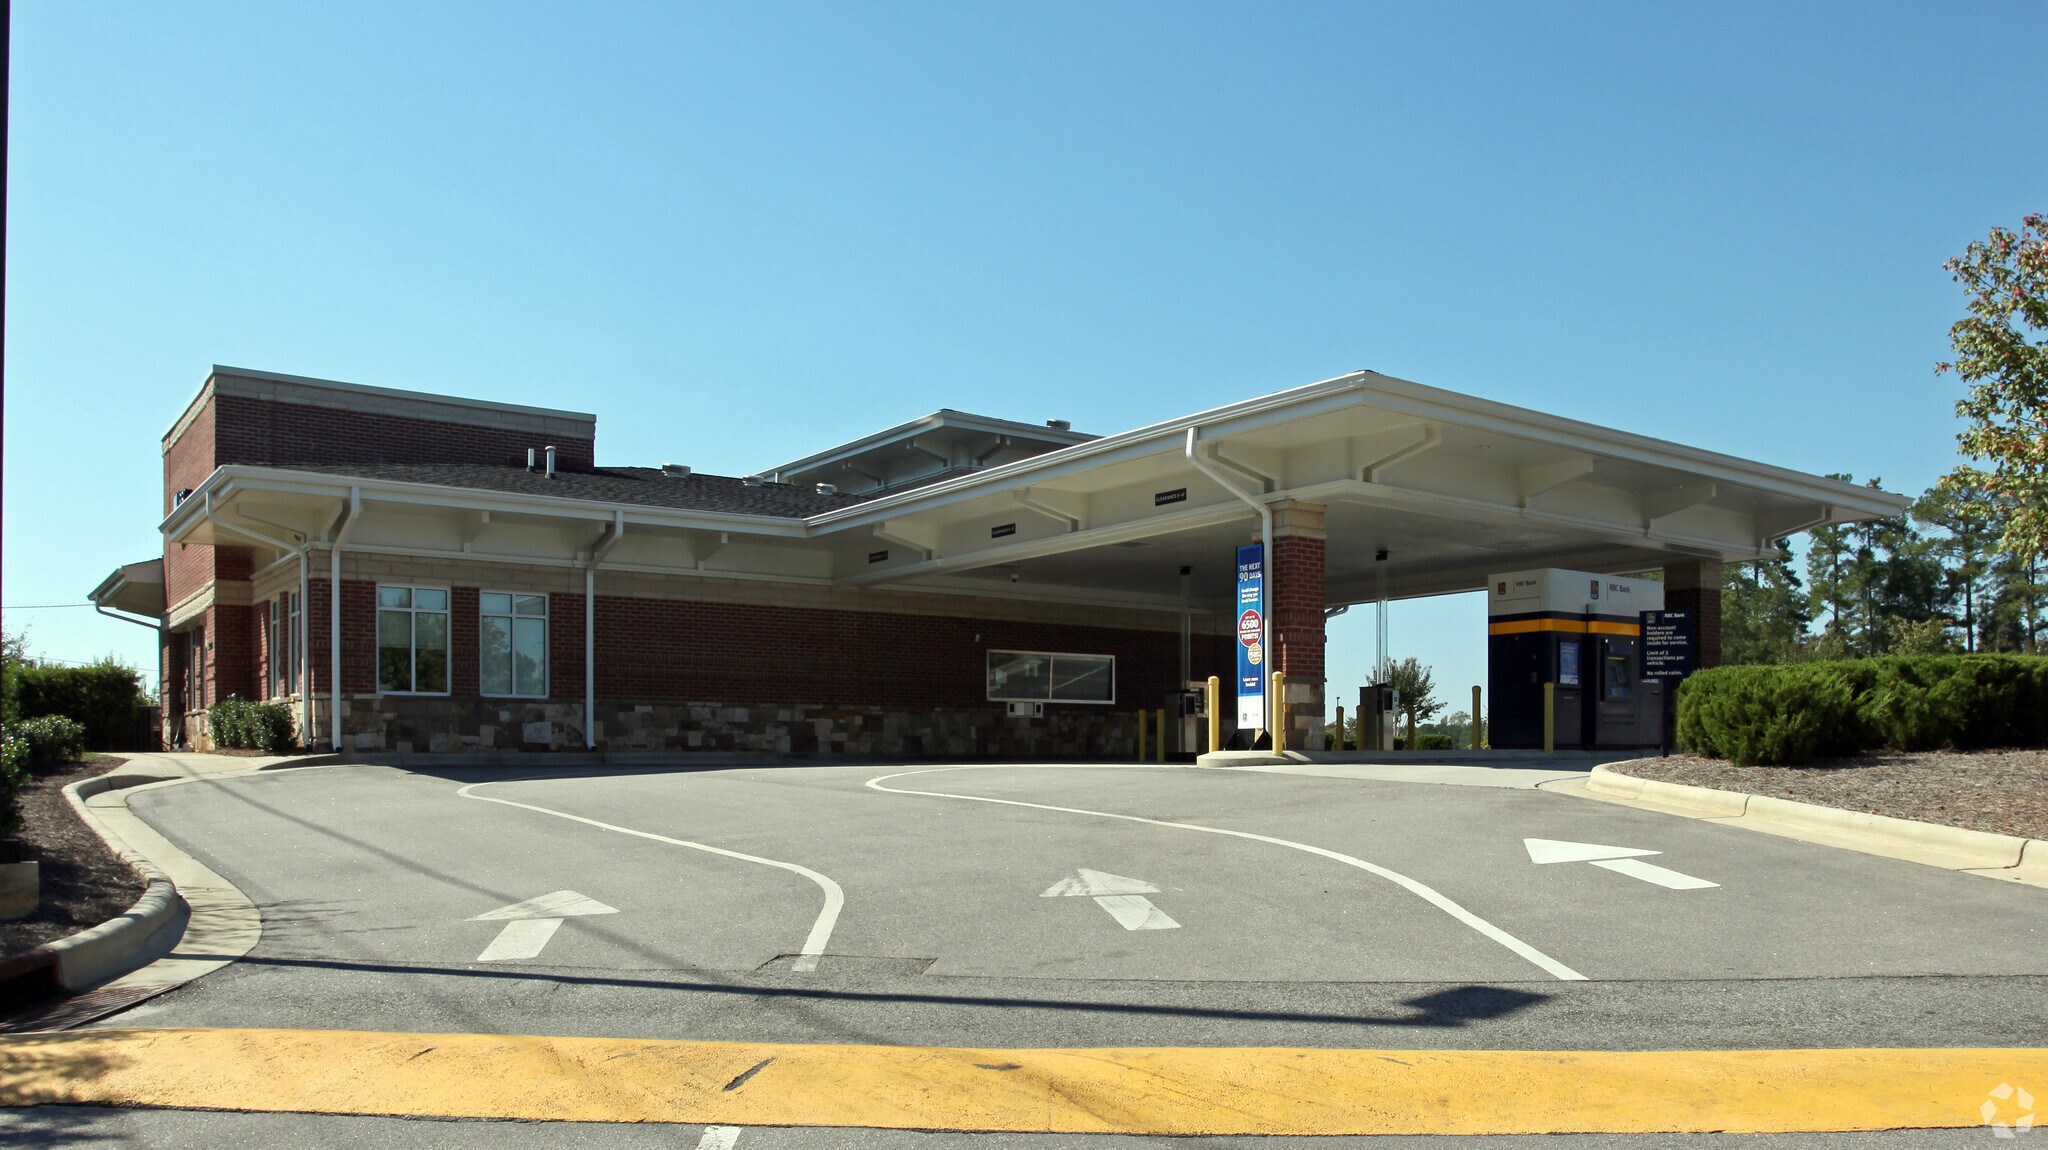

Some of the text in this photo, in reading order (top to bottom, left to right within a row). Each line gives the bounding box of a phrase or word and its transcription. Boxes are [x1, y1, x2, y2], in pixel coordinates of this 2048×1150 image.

[1249, 562, 1260, 570] NEXT
[1239, 572, 1248, 583] 90
[1609, 583, 1630, 593] RBC Bank
[1242, 619, 1259, 629] 6500
